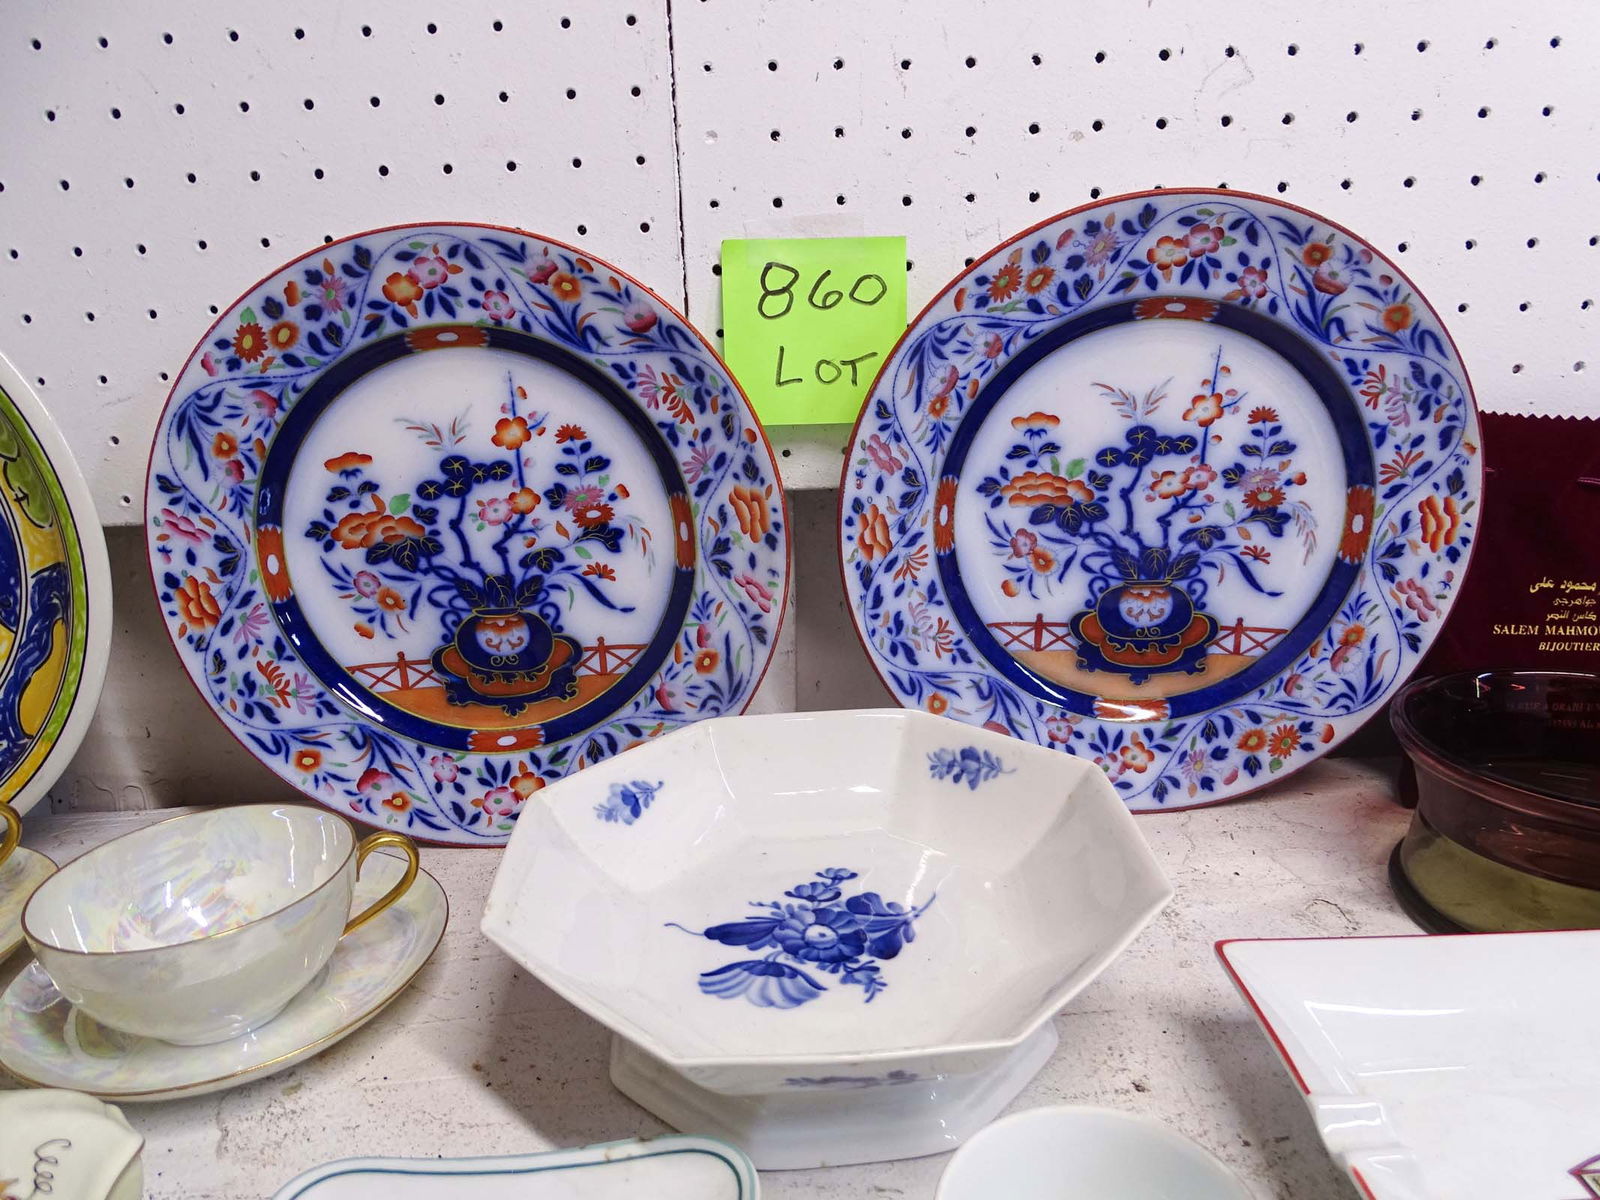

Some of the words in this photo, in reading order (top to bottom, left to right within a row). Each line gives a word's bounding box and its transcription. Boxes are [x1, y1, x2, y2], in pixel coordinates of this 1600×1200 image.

[758, 261, 888, 320] 860
[776, 345, 878, 387] LOT
[1560, 579, 1597, 593] محمود
[1492, 624, 1540, 635] SALEM
[1545, 624, 1600, 636] MAHMO
